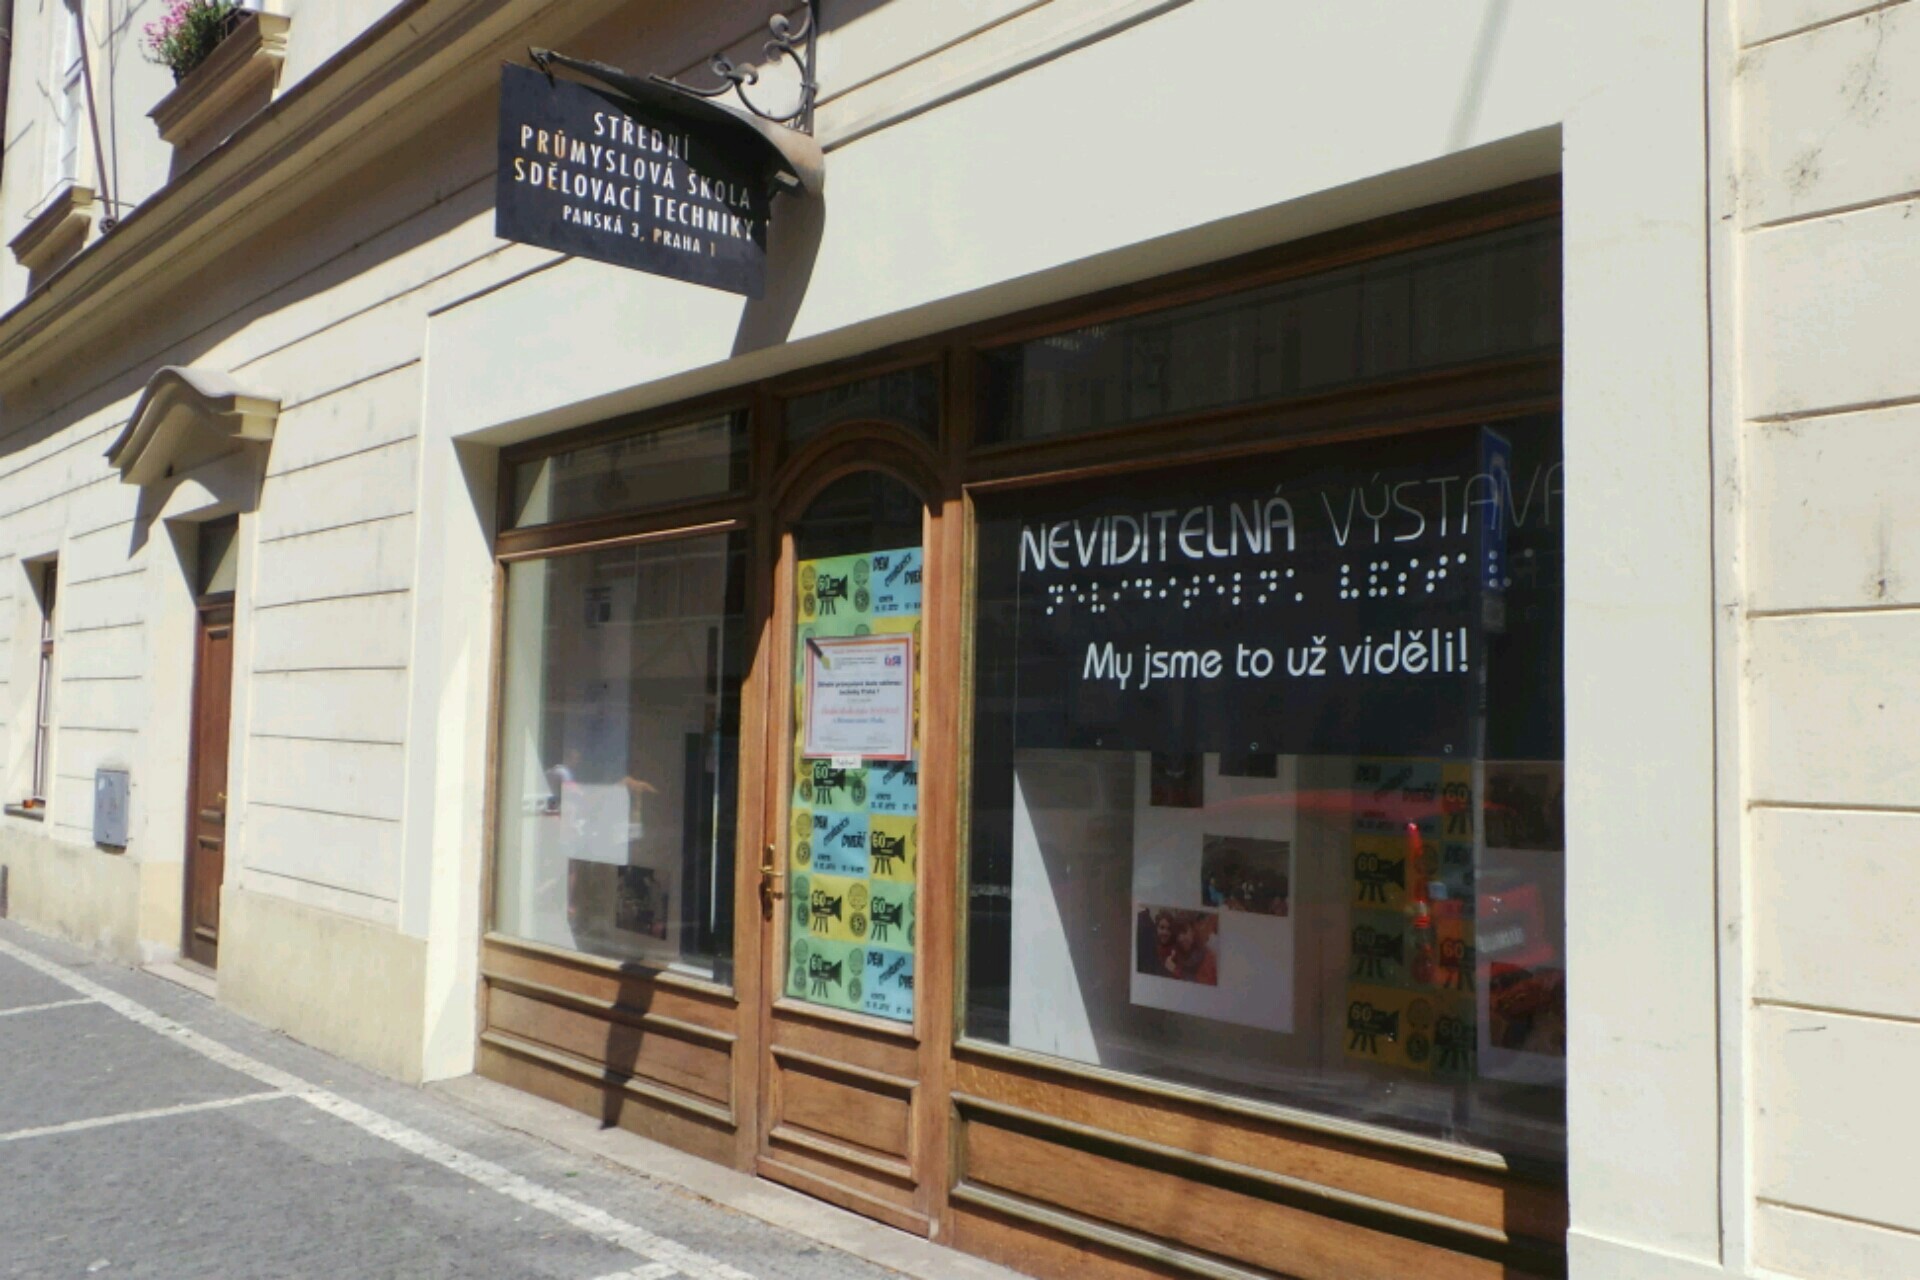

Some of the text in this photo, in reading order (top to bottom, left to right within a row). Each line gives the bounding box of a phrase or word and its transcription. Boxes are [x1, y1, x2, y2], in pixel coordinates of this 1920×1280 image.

[520, 124, 751, 209] PRŮMYSLOVÁ ŠKOLA
[594, 111, 690, 160] STŘEDNÍ
[514, 156, 754, 242] SDĚLOVACÍ TECHNIKY
[563, 205, 623, 235] PANSKÁ
[653, 228, 701, 253] PRAHA
[709, 243, 716, 257] 1
[1020, 484, 1296, 572] NEVIDITELNÁ
[1083, 627, 1469, 690] My jsme to už viděli!
